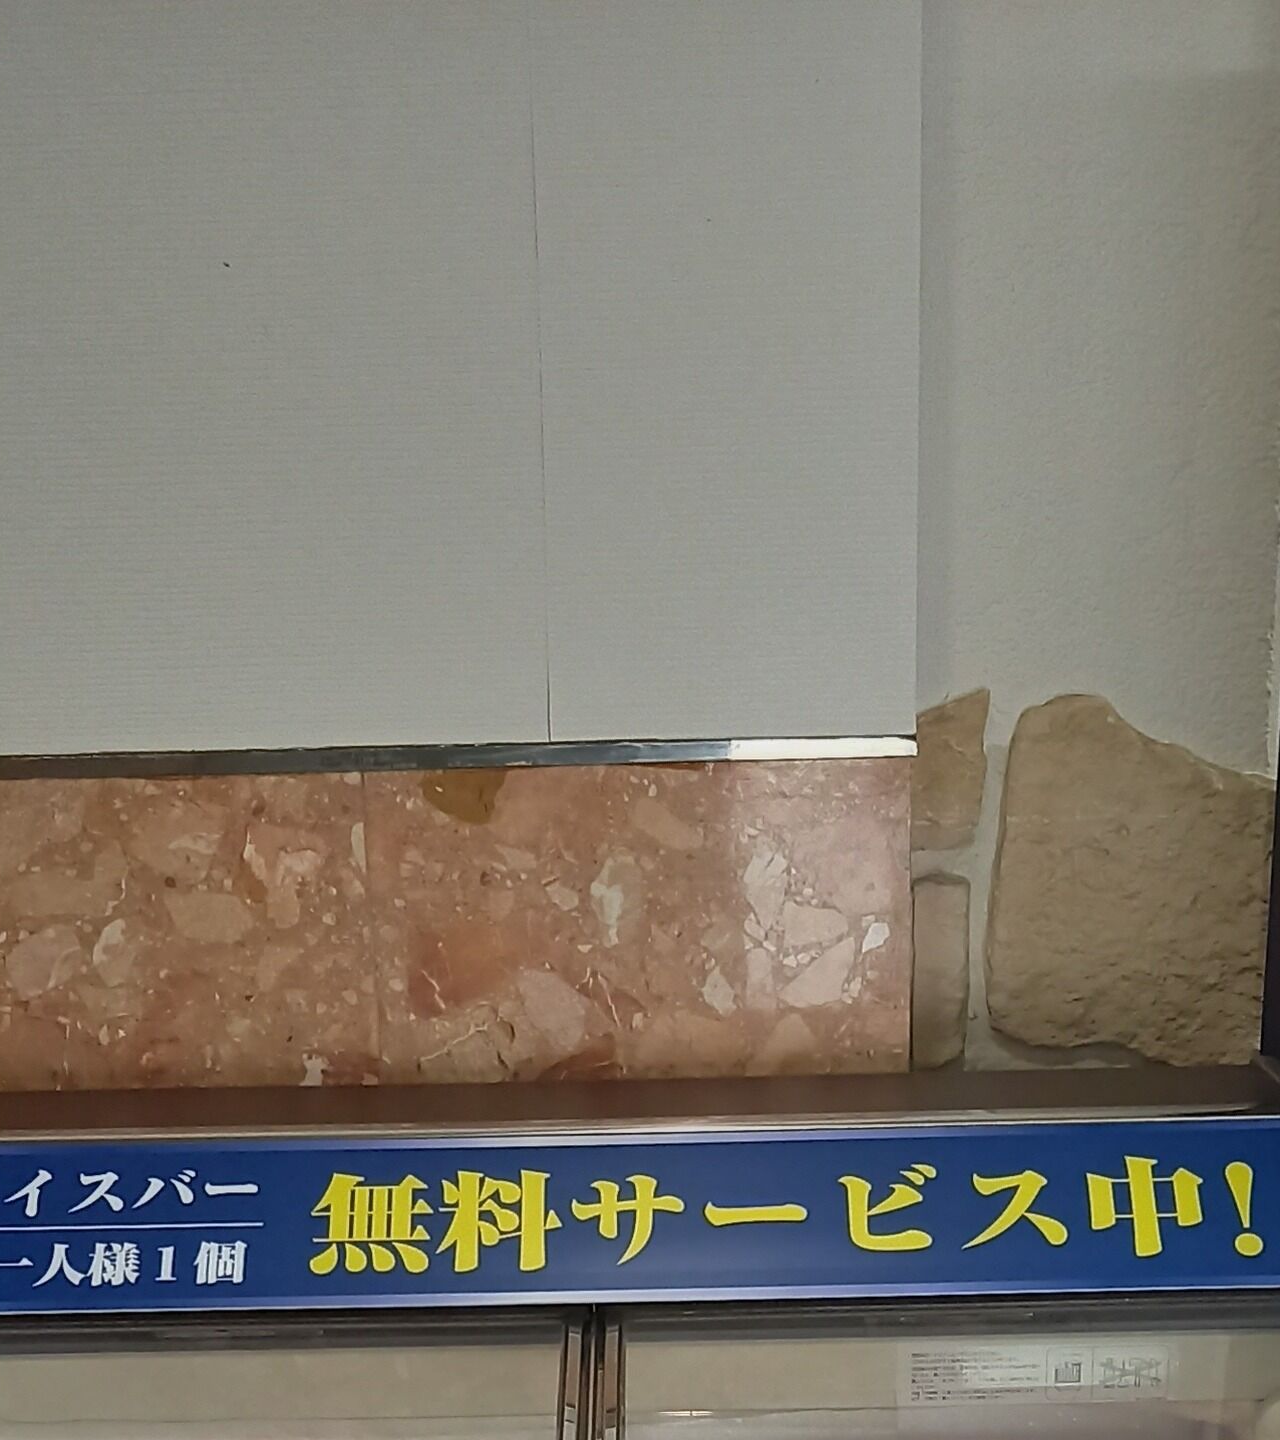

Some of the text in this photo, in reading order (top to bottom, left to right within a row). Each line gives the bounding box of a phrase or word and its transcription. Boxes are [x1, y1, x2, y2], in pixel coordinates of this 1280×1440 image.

[309, 1155, 1264, 1275] 無料サービス中!
